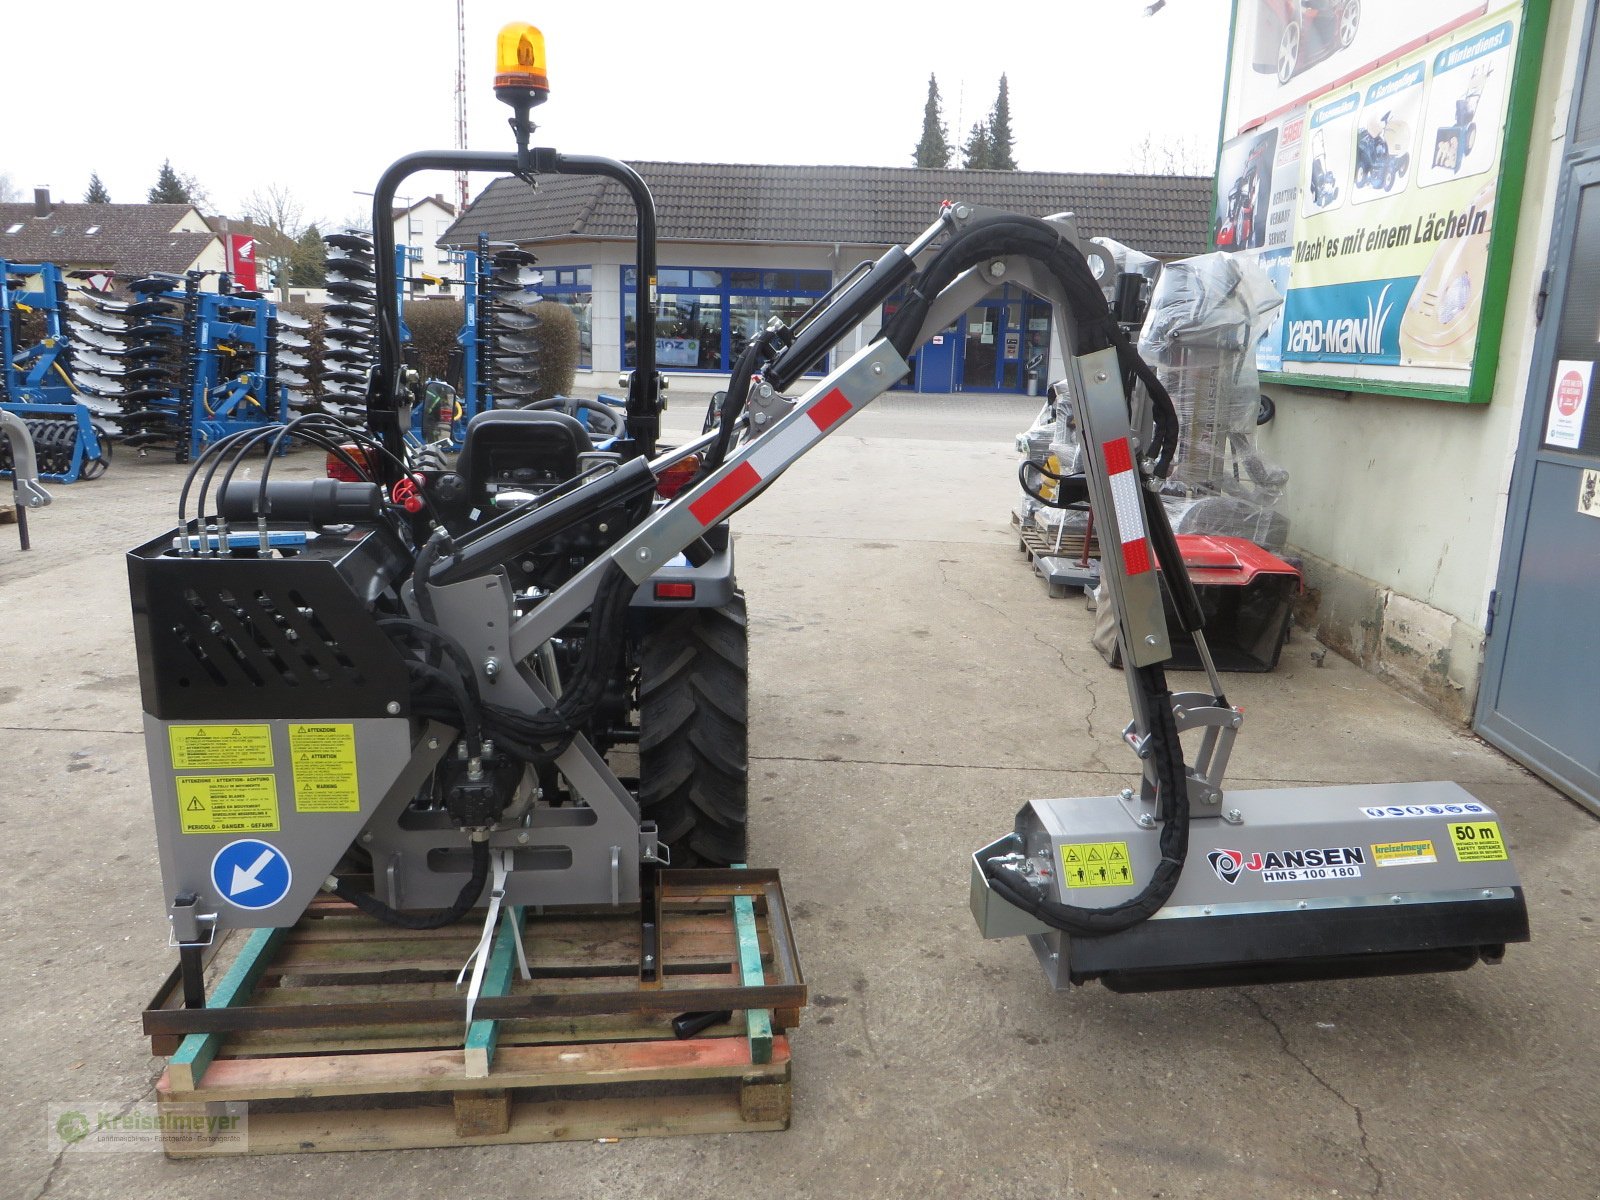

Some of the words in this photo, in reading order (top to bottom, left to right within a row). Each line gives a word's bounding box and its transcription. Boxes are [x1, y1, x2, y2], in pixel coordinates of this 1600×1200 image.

[1448, 29, 1505, 66] Winterdienst
[1272, 186, 1297, 206] BERATUNG
[1268, 230, 1287, 246] SERVICE
[1295, 235, 1326, 263] Mach'
[1326, 236, 1339, 258] es
[1340, 227, 1365, 256] mit
[1366, 223, 1412, 252] einem
[1414, 205, 1488, 244] Lächeln
[1455, 825, 1475, 840] 50
[1479, 827, 1494, 839] m
[1245, 847, 1366, 871] JANSEN
[1264, 870, 1297, 881] HMS
